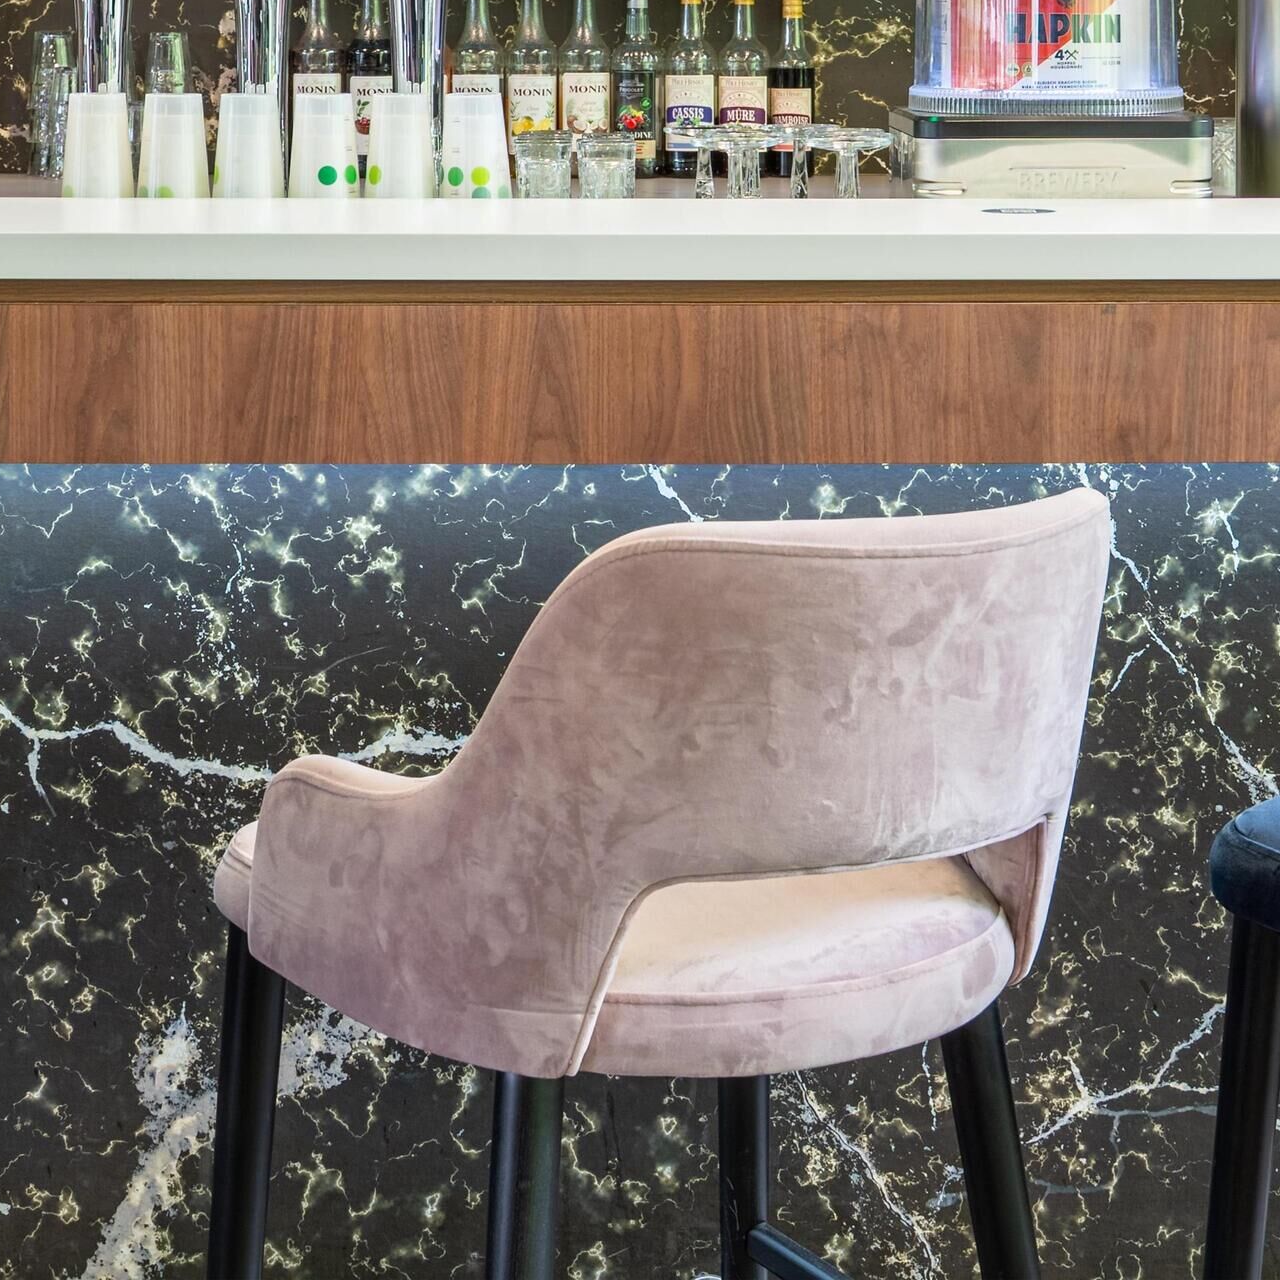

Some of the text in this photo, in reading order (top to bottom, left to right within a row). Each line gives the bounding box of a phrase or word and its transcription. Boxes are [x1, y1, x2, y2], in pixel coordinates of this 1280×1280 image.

[1006, 13, 1122, 44] HAPKIN
[297, 85, 337, 94] MONIN
[454, 86, 493, 94] MONIN
[513, 88, 553, 97] MONIN
[568, 85, 608, 94] MONIN
[672, 107, 705, 120] CASSIS
[726, 106, 756, 122] MÛRE
